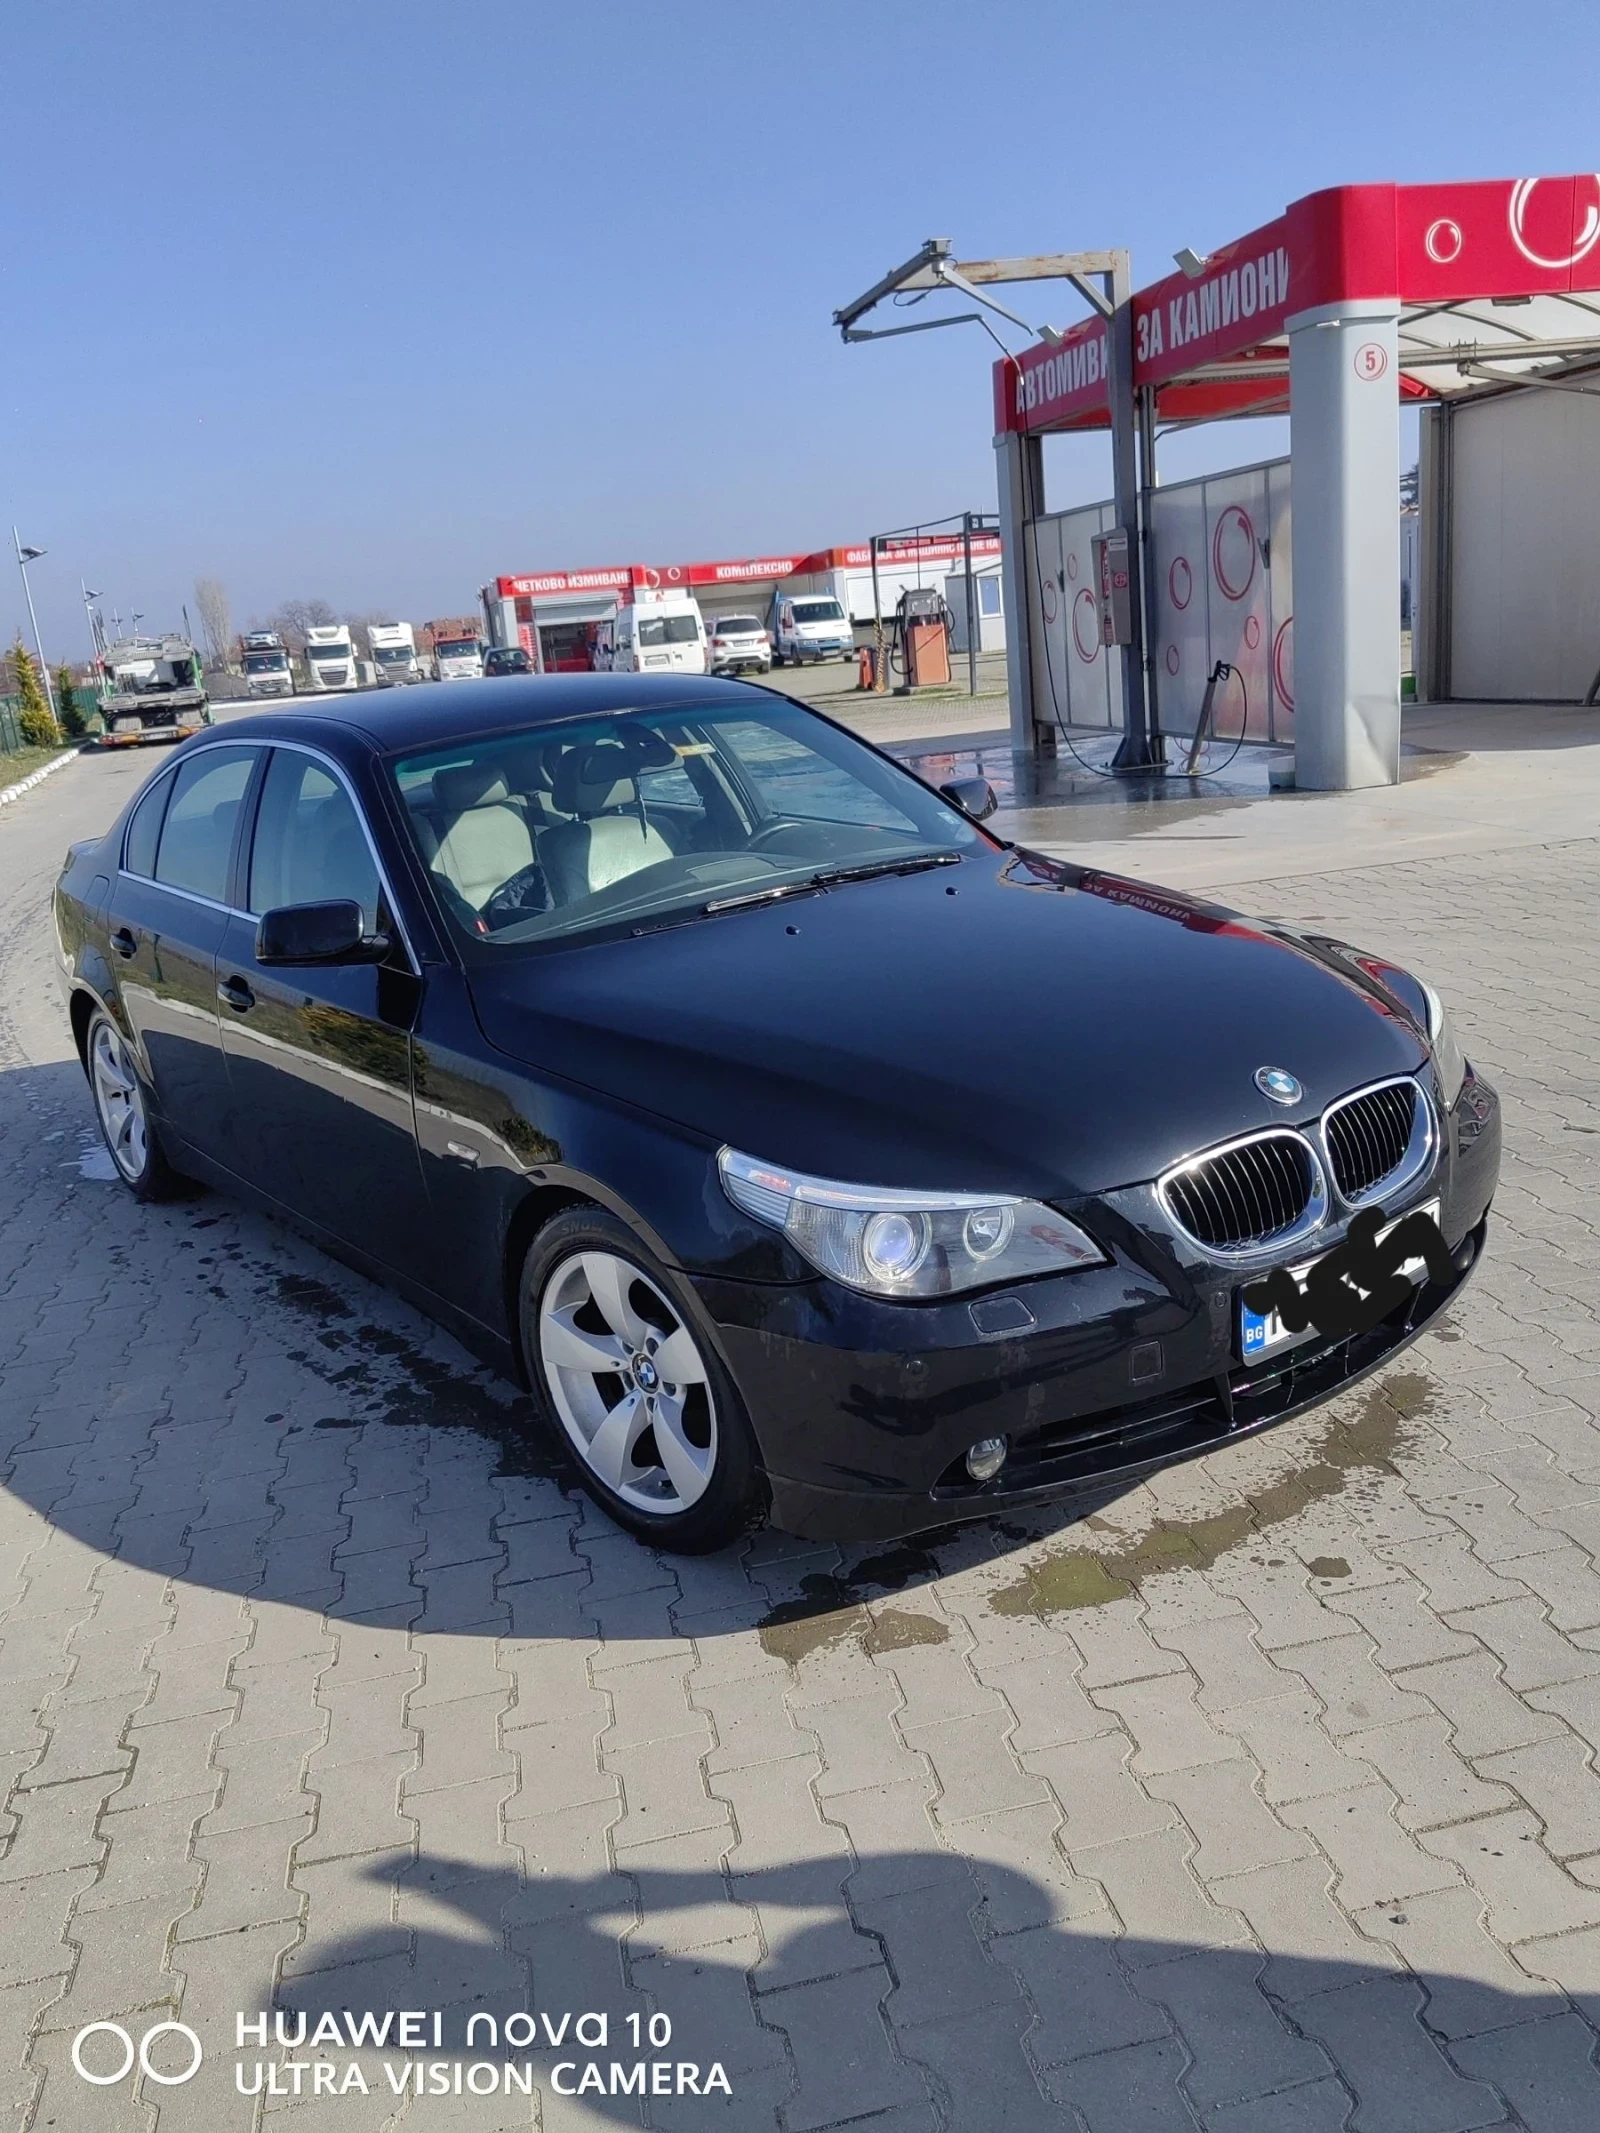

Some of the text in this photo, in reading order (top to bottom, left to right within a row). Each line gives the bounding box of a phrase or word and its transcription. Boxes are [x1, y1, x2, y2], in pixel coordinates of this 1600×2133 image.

[1137, 307, 1164, 363] ЗА
[1169, 247, 1289, 350] КАМИОНИ
[1365, 350, 1376, 371] 5
[513, 578, 567, 593] ЧЕТКОВО
[1246, 1325, 1263, 1343] BG
